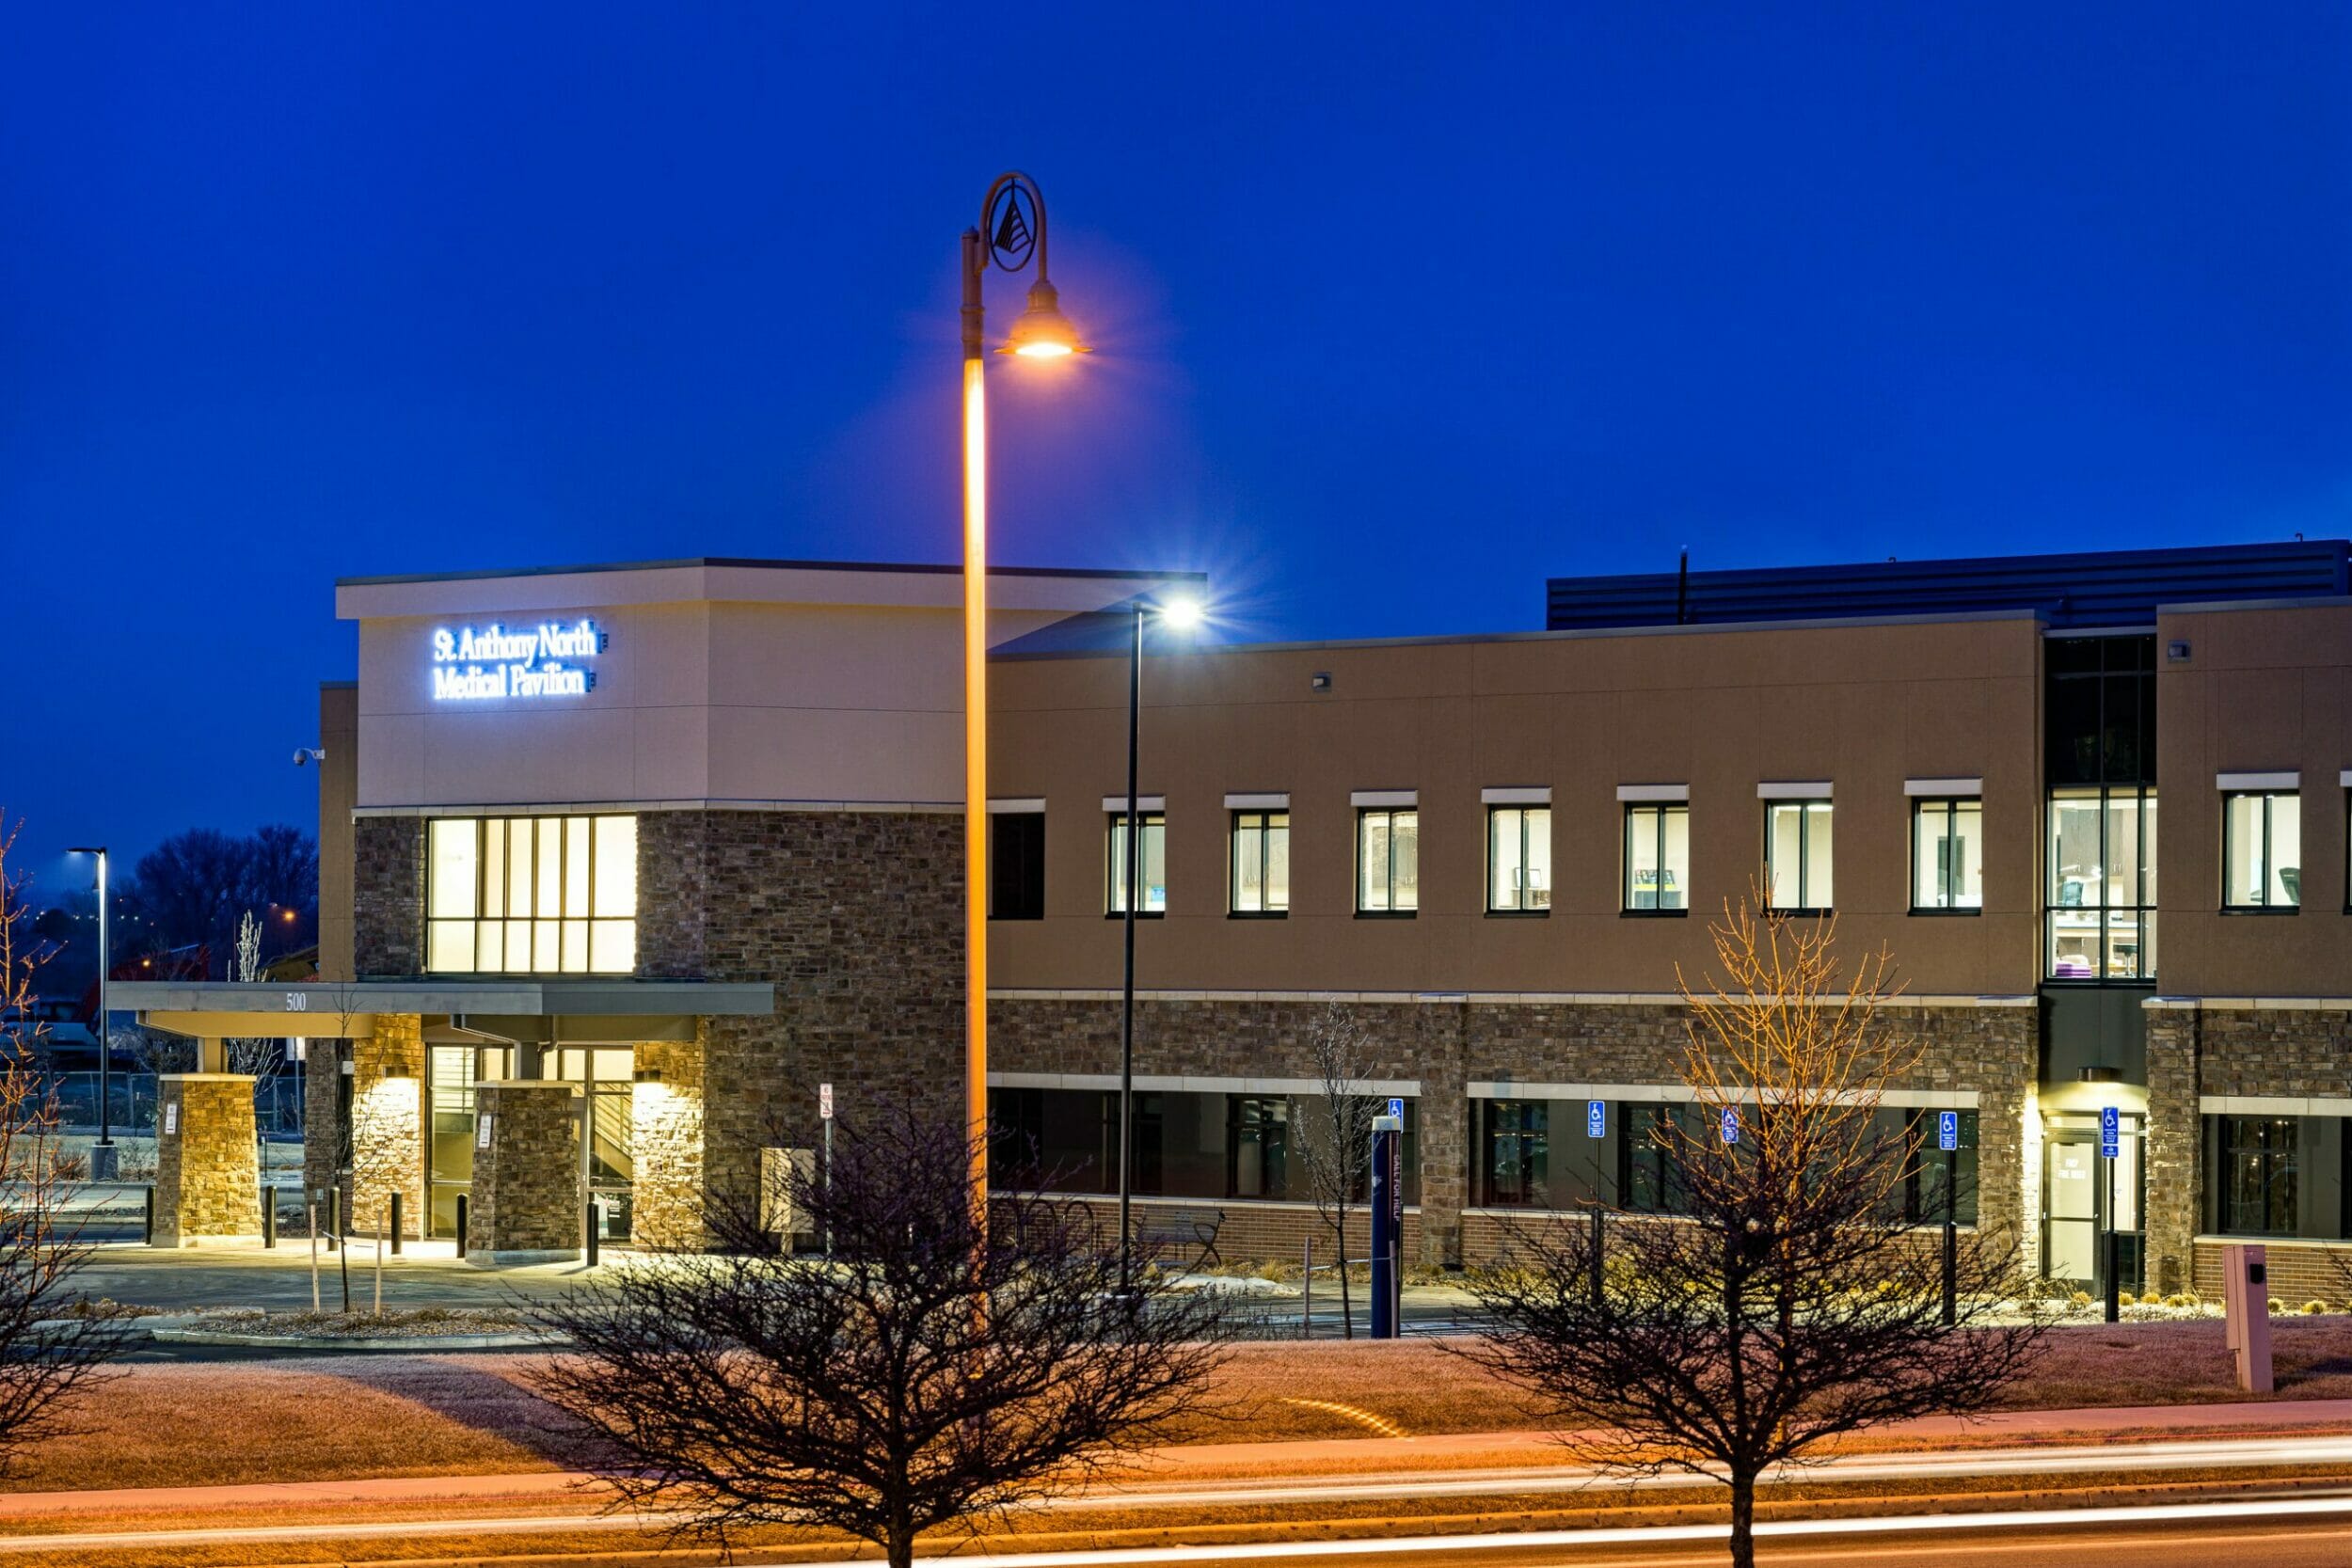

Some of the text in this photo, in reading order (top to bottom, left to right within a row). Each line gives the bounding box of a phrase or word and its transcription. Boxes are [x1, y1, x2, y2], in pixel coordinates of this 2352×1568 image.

[435, 620, 596, 668] St. Anthony North
[434, 662, 585, 699] Medical Pavilion
[286, 992, 306, 1011] 500
